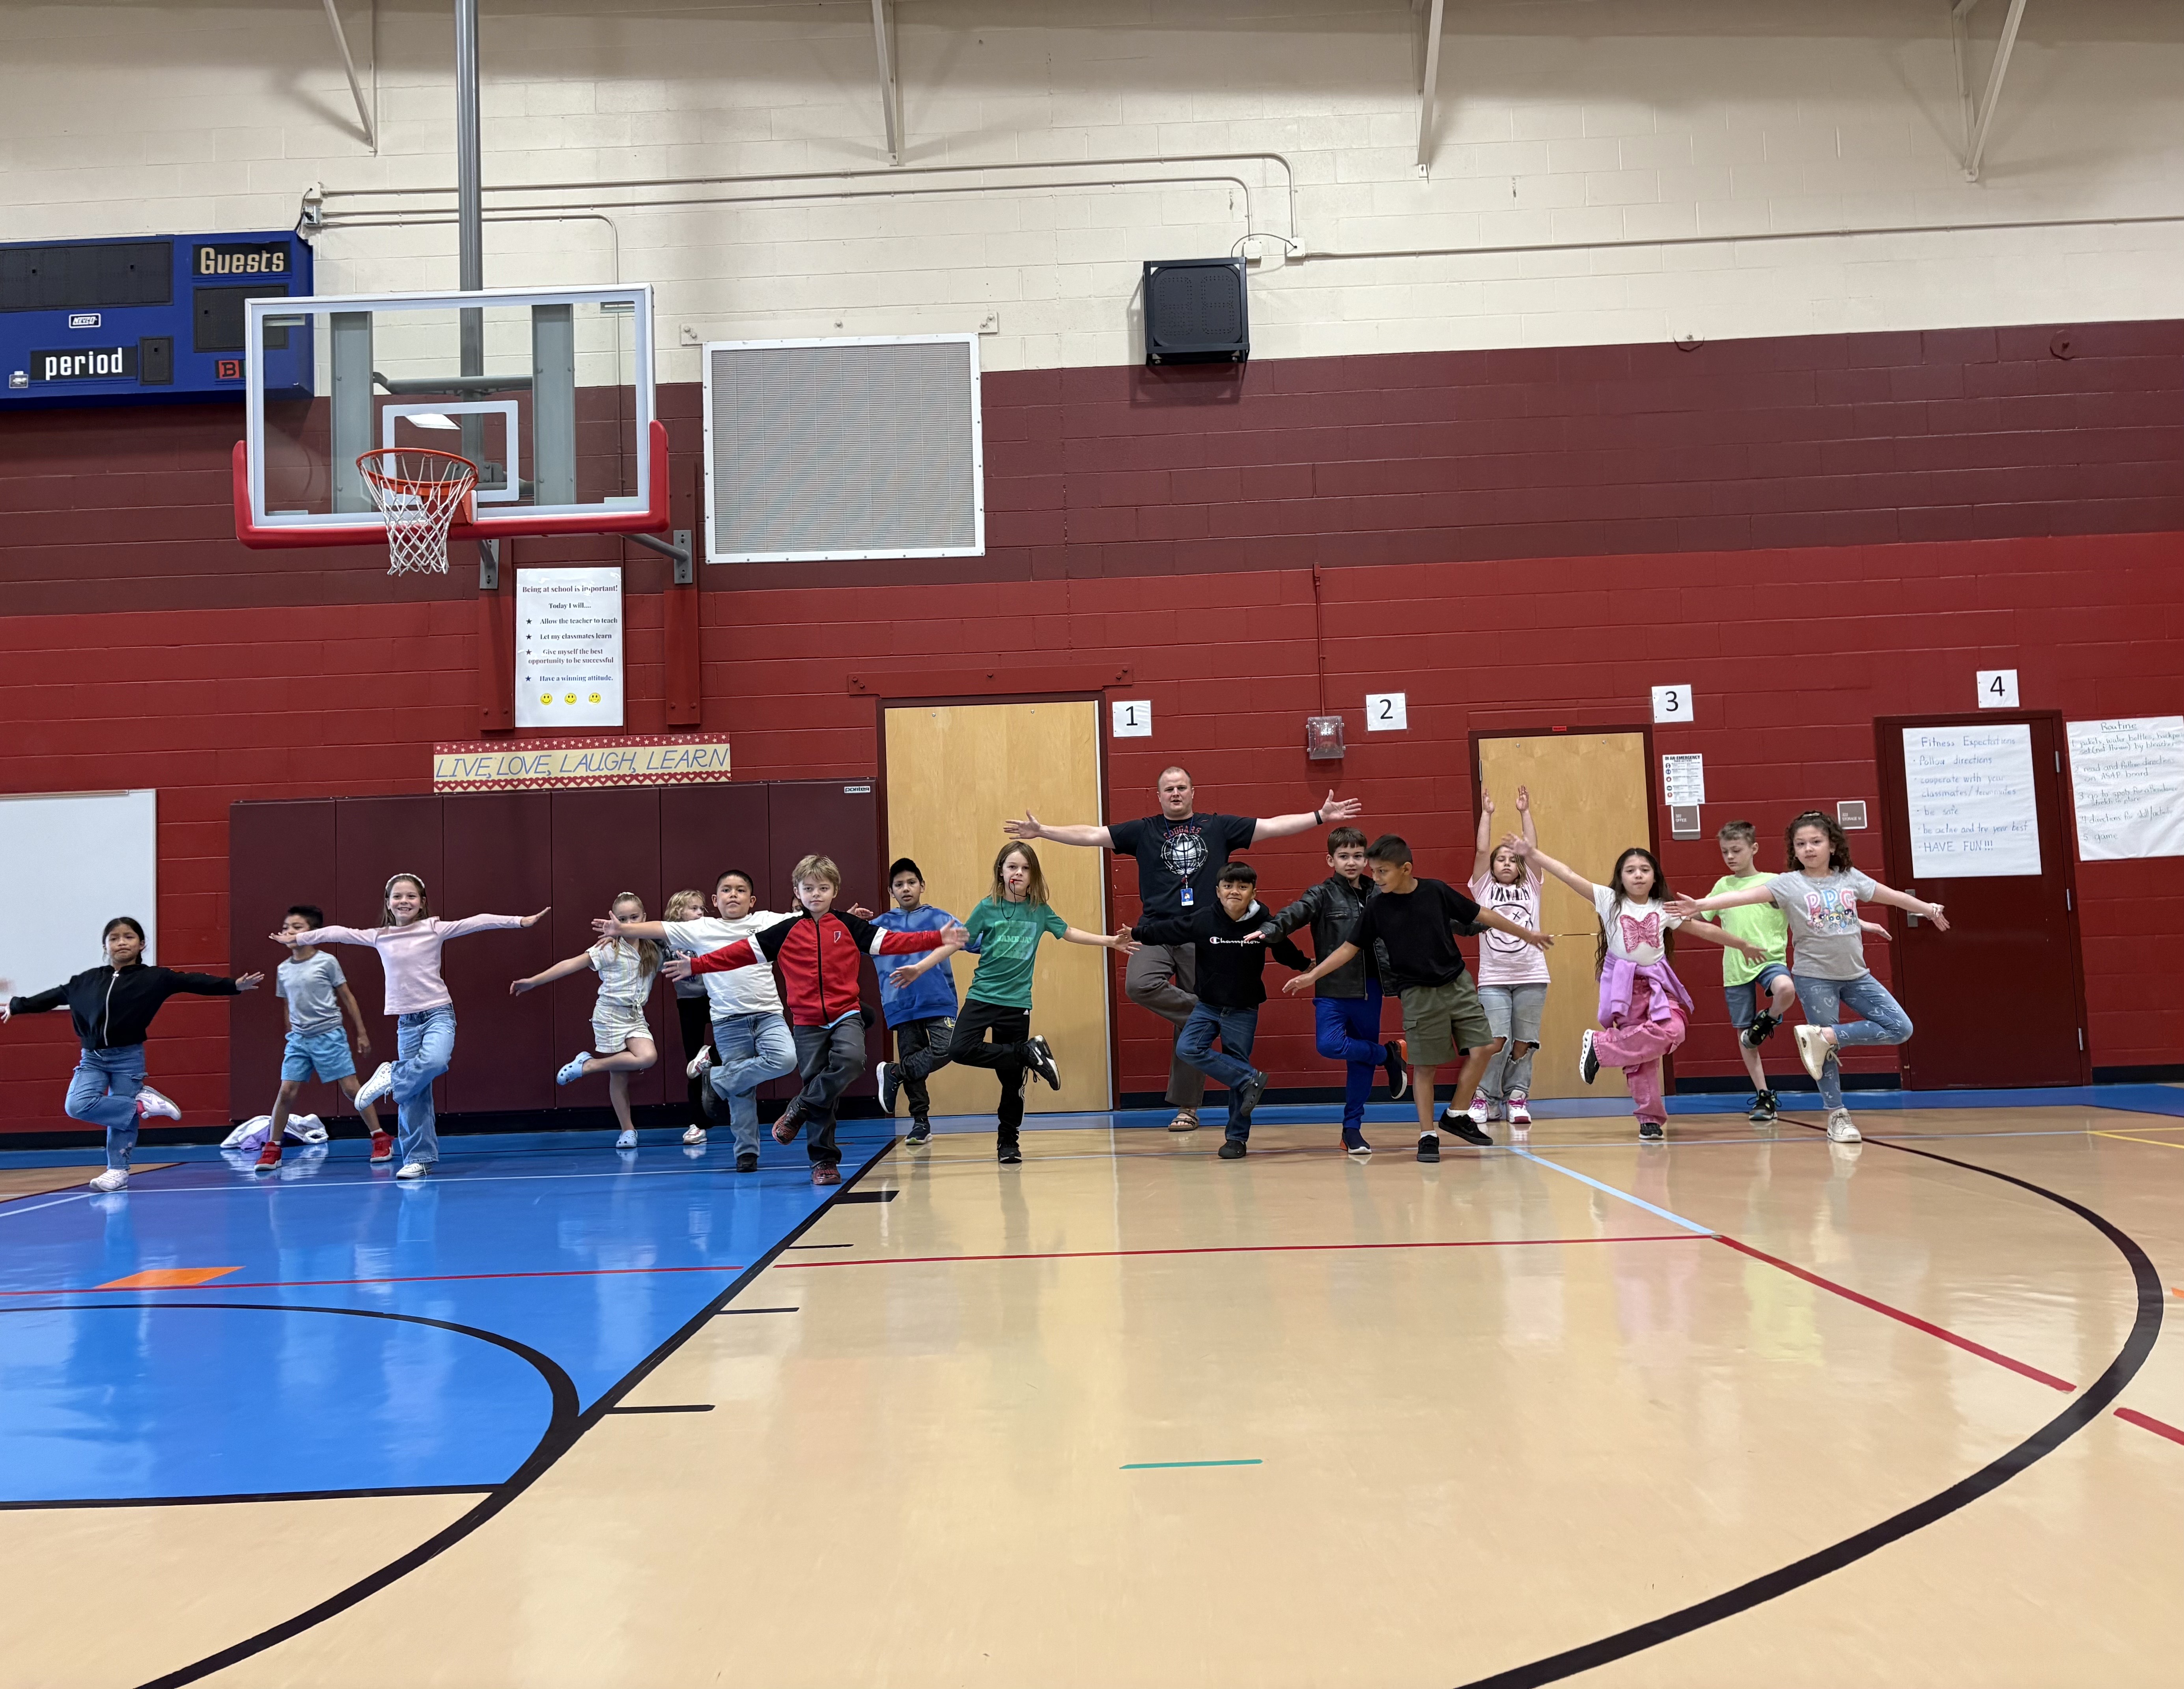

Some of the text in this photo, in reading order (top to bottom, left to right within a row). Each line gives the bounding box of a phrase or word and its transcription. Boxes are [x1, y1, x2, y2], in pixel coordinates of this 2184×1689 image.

[200, 247, 285, 274] Guests
[45, 348, 123, 380] period
[221, 362, 237, 377] B
[1990, 676, 2005, 697] 4
[1665, 691, 1678, 712] 3
[1379, 699, 1393, 719] 2
[1126, 706, 1138, 726] 1
[2101, 720, 2137, 731] Routine
[1921, 735, 2015, 748] Fitness Expectations
[436, 748, 728, 778] LIVE, LOVE, LAUGH, LEARN
[1954, 755, 1992, 764] directions
[2104, 761, 2118, 770] and
[2126, 768, 2148, 777] board
[1921, 773, 2004, 785] cooperate with your
[2102, 789, 2108, 798] to
[1925, 805, 1958, 816] be safe
[1163, 825, 1202, 840] COUGARS
[2094, 833, 2118, 843] game
[1924, 841, 1955, 852] HAVE
[1210, 936, 1260, 947] Champion
